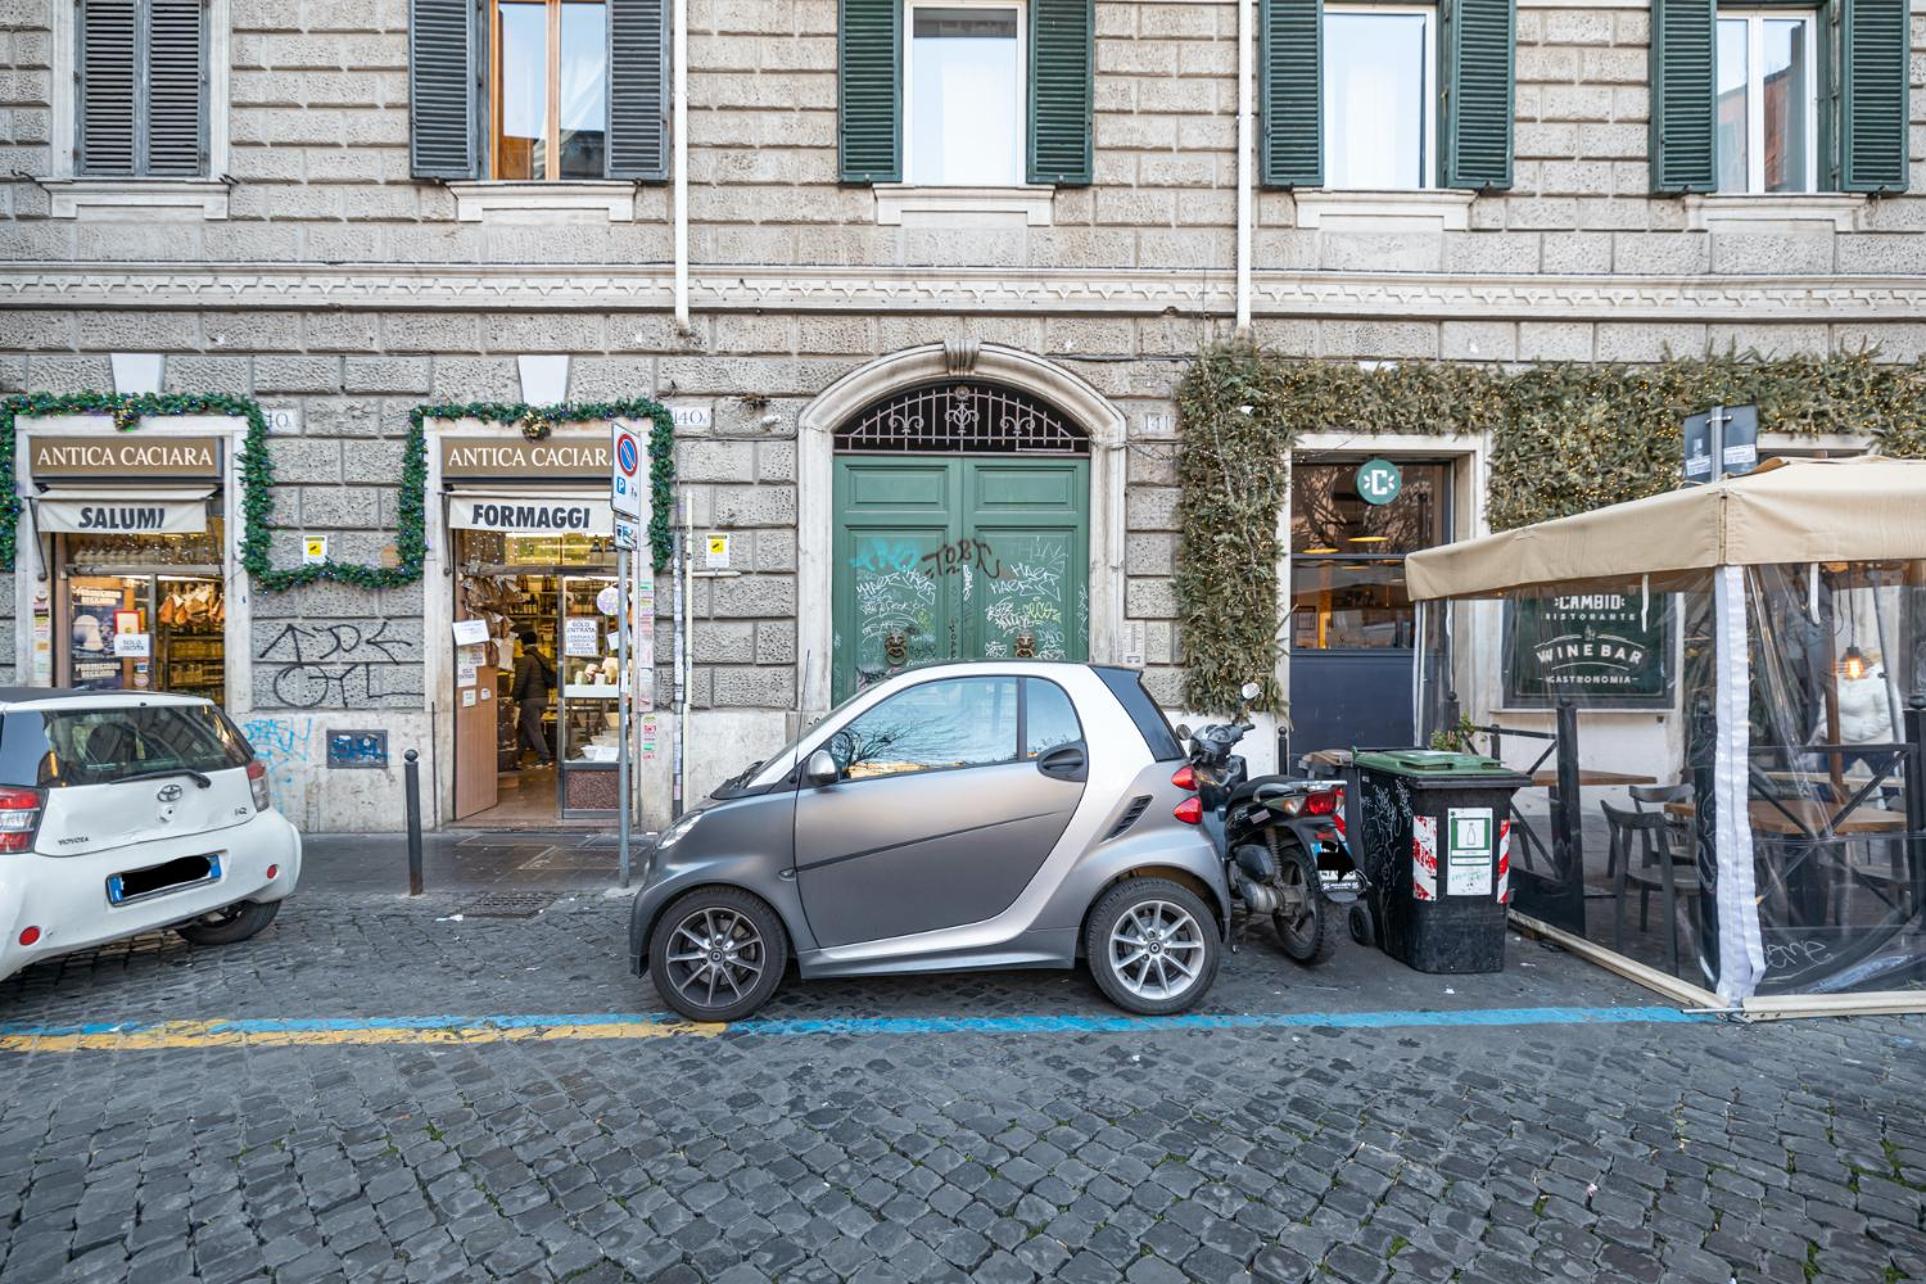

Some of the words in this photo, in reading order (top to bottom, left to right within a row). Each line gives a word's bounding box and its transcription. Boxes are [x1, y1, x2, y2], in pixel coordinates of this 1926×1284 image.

[37, 446, 116, 466] ANTICA
[120, 446, 213, 466] CACIARA
[448, 447, 526, 468] ANTICA
[531, 447, 613, 468] CACIAR
[78, 507, 166, 530] SALUMI
[472, 504, 591, 530] FORMAGGI
[1559, 594, 1621, 610] CAMBIO
[1545, 612, 1636, 621] RISTORANTE
[1536, 644, 1593, 663] WINE
[1600, 644, 1643, 664] BAR
[1549, 675, 1632, 684] GASTRONOMIA
